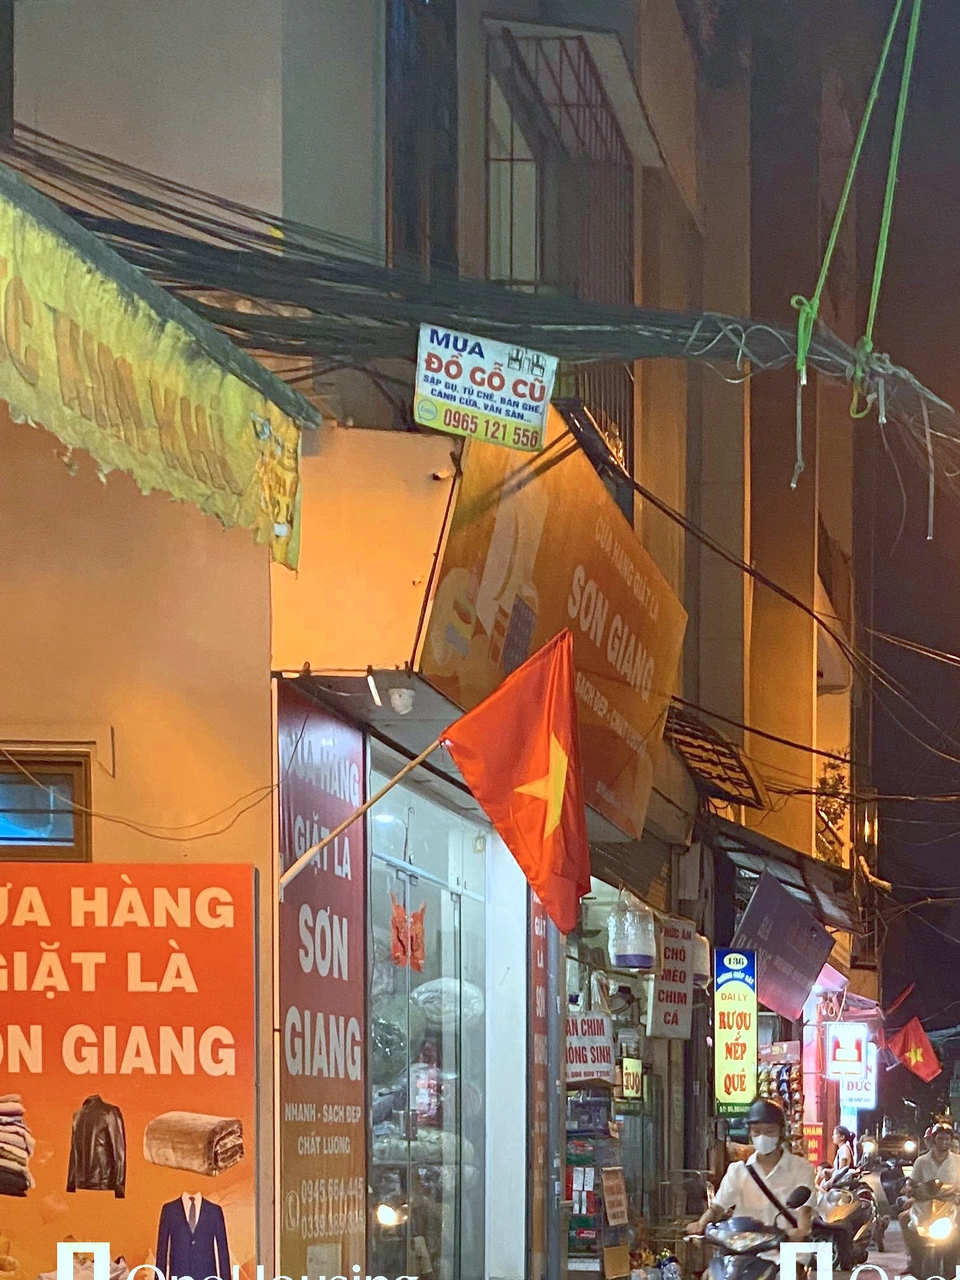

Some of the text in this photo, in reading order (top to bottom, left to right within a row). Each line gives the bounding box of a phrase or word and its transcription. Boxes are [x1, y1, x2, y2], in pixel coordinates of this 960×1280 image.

[430, 328, 485, 359] MUA
[425, 352, 546, 402] ĐỒ GỖ CŨ
[443, 408, 540, 448] 0965 121 556
[606, 613, 655, 703] GIANG
[71, 873, 235, 929] HÀNG
[299, 904, 348, 981] SƠN
[664, 946, 686, 961] CHÓ
[0, 938, 199, 999] IẶT LÀ
[661, 966, 686, 983] MÈO
[658, 990, 687, 1005] CHIM
[581, 1018, 605, 1036] CHIM
[664, 1009, 679, 1026] CÁ
[62, 1023, 236, 1077] GIANG
[285, 1005, 361, 1081] GIANG
[590, 1046, 611, 1064] SINH
[725, 1032, 747, 1061] NẾP
[724, 1068, 747, 1096] QUÊ
[285, 1103, 316, 1122] NHANH
